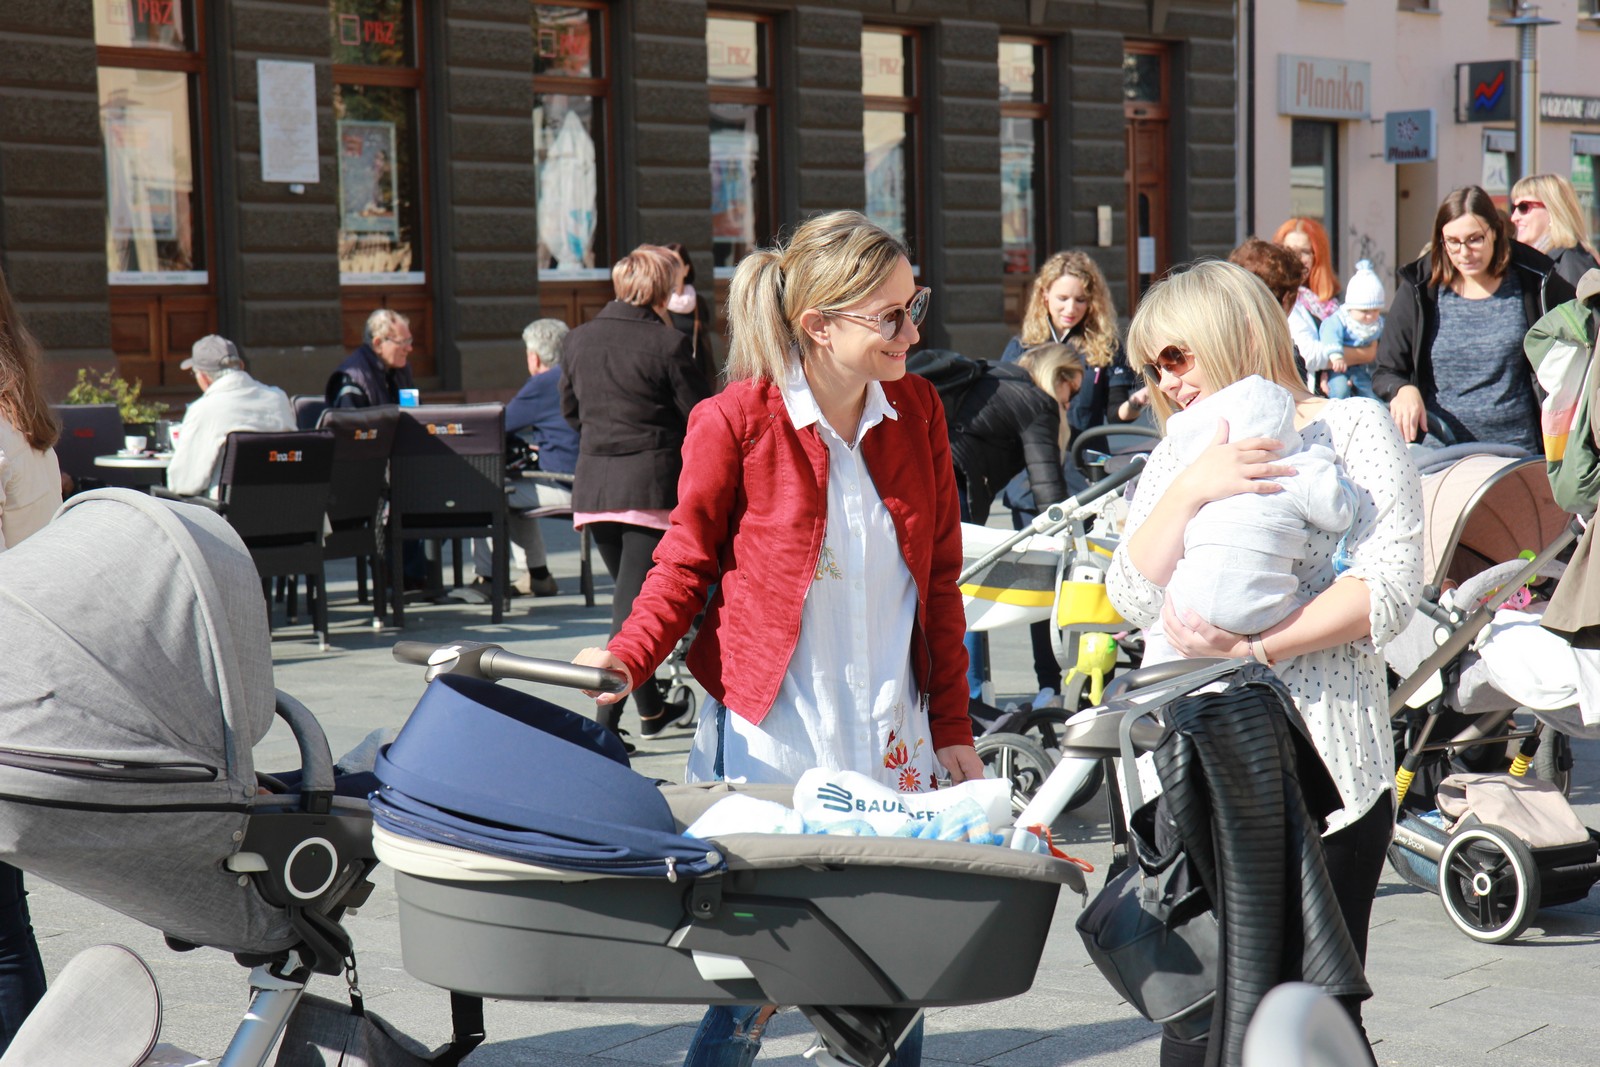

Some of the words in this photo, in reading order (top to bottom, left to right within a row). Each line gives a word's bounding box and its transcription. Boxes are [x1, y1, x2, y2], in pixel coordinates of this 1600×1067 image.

[137, 0, 174, 25] PBZ
[363, 20, 396, 45] PBZ
[727, 46, 752, 67] PBZ
[1295, 61, 1364, 113] Planika
